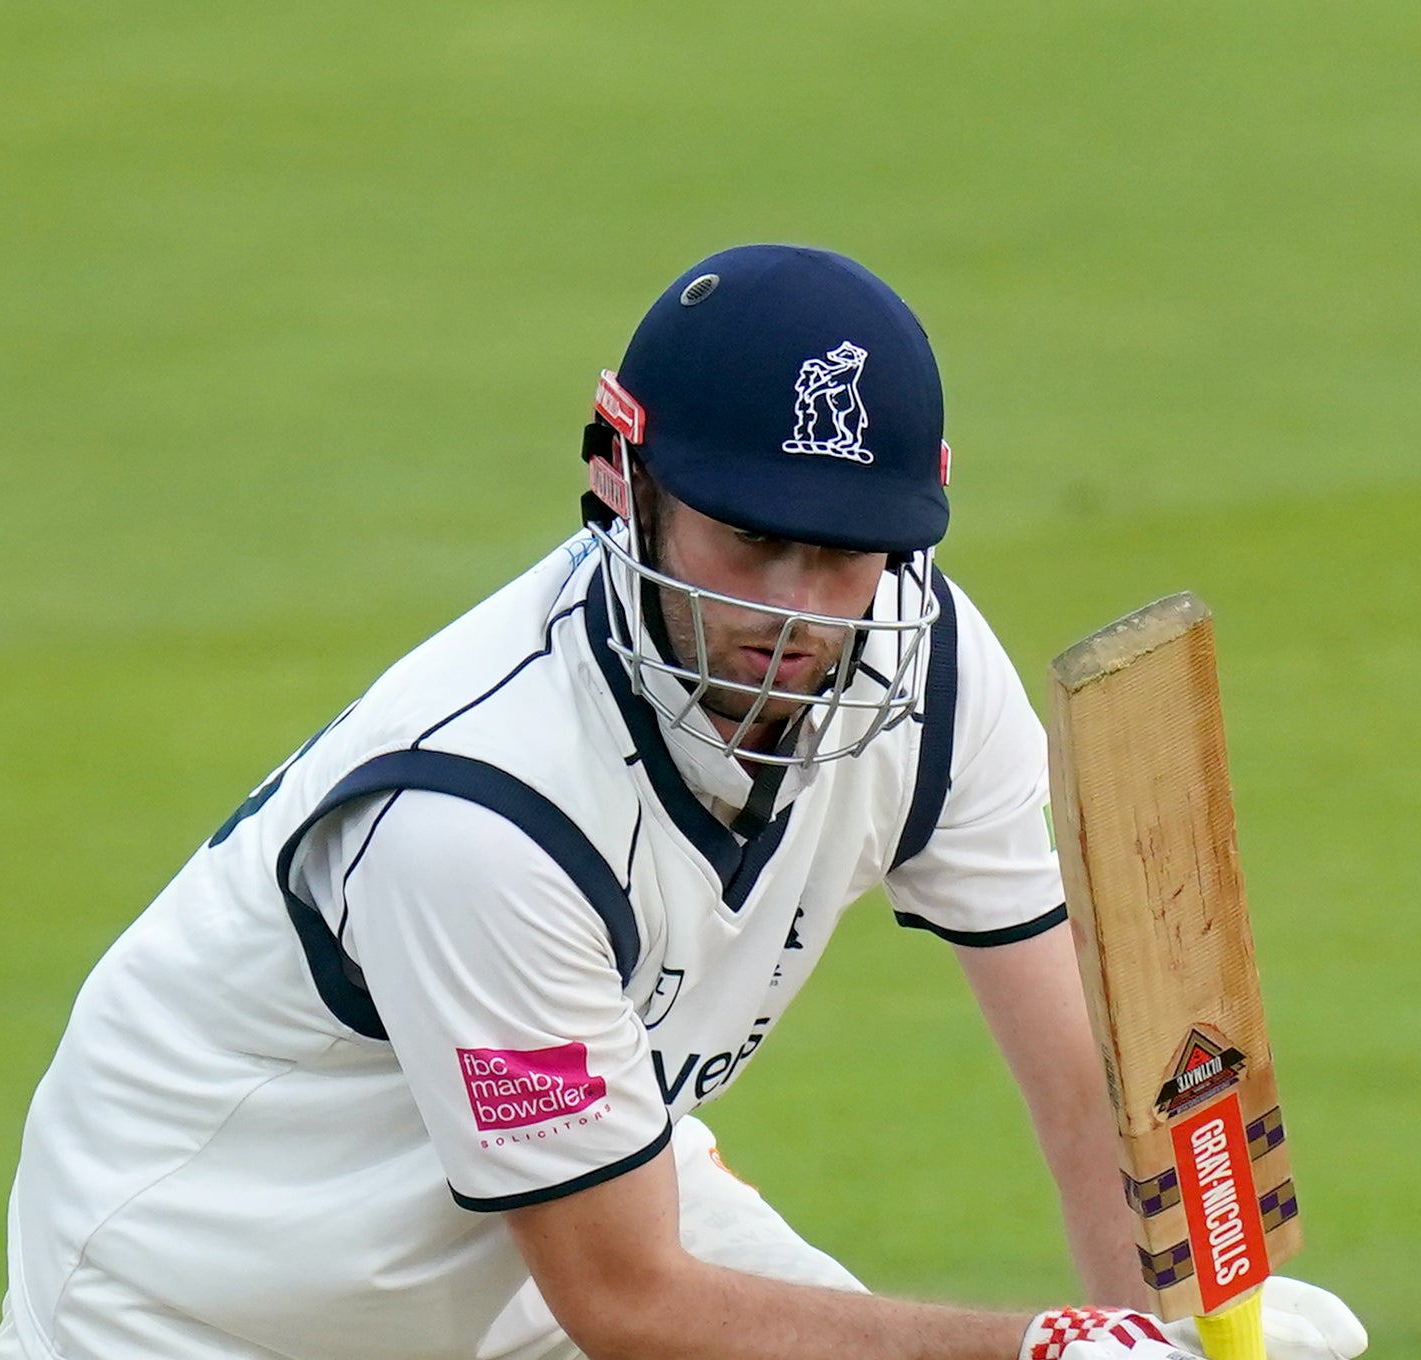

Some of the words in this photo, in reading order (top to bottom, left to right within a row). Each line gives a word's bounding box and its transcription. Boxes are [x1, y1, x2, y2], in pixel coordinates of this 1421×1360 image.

[463, 1053, 507, 1076] fbc
[1177, 1056, 1224, 1094] ULTIMATE
[471, 1071, 564, 1098] manby
[476, 1083, 589, 1123] bowdler
[481, 1104, 611, 1149] SOLICITORS
